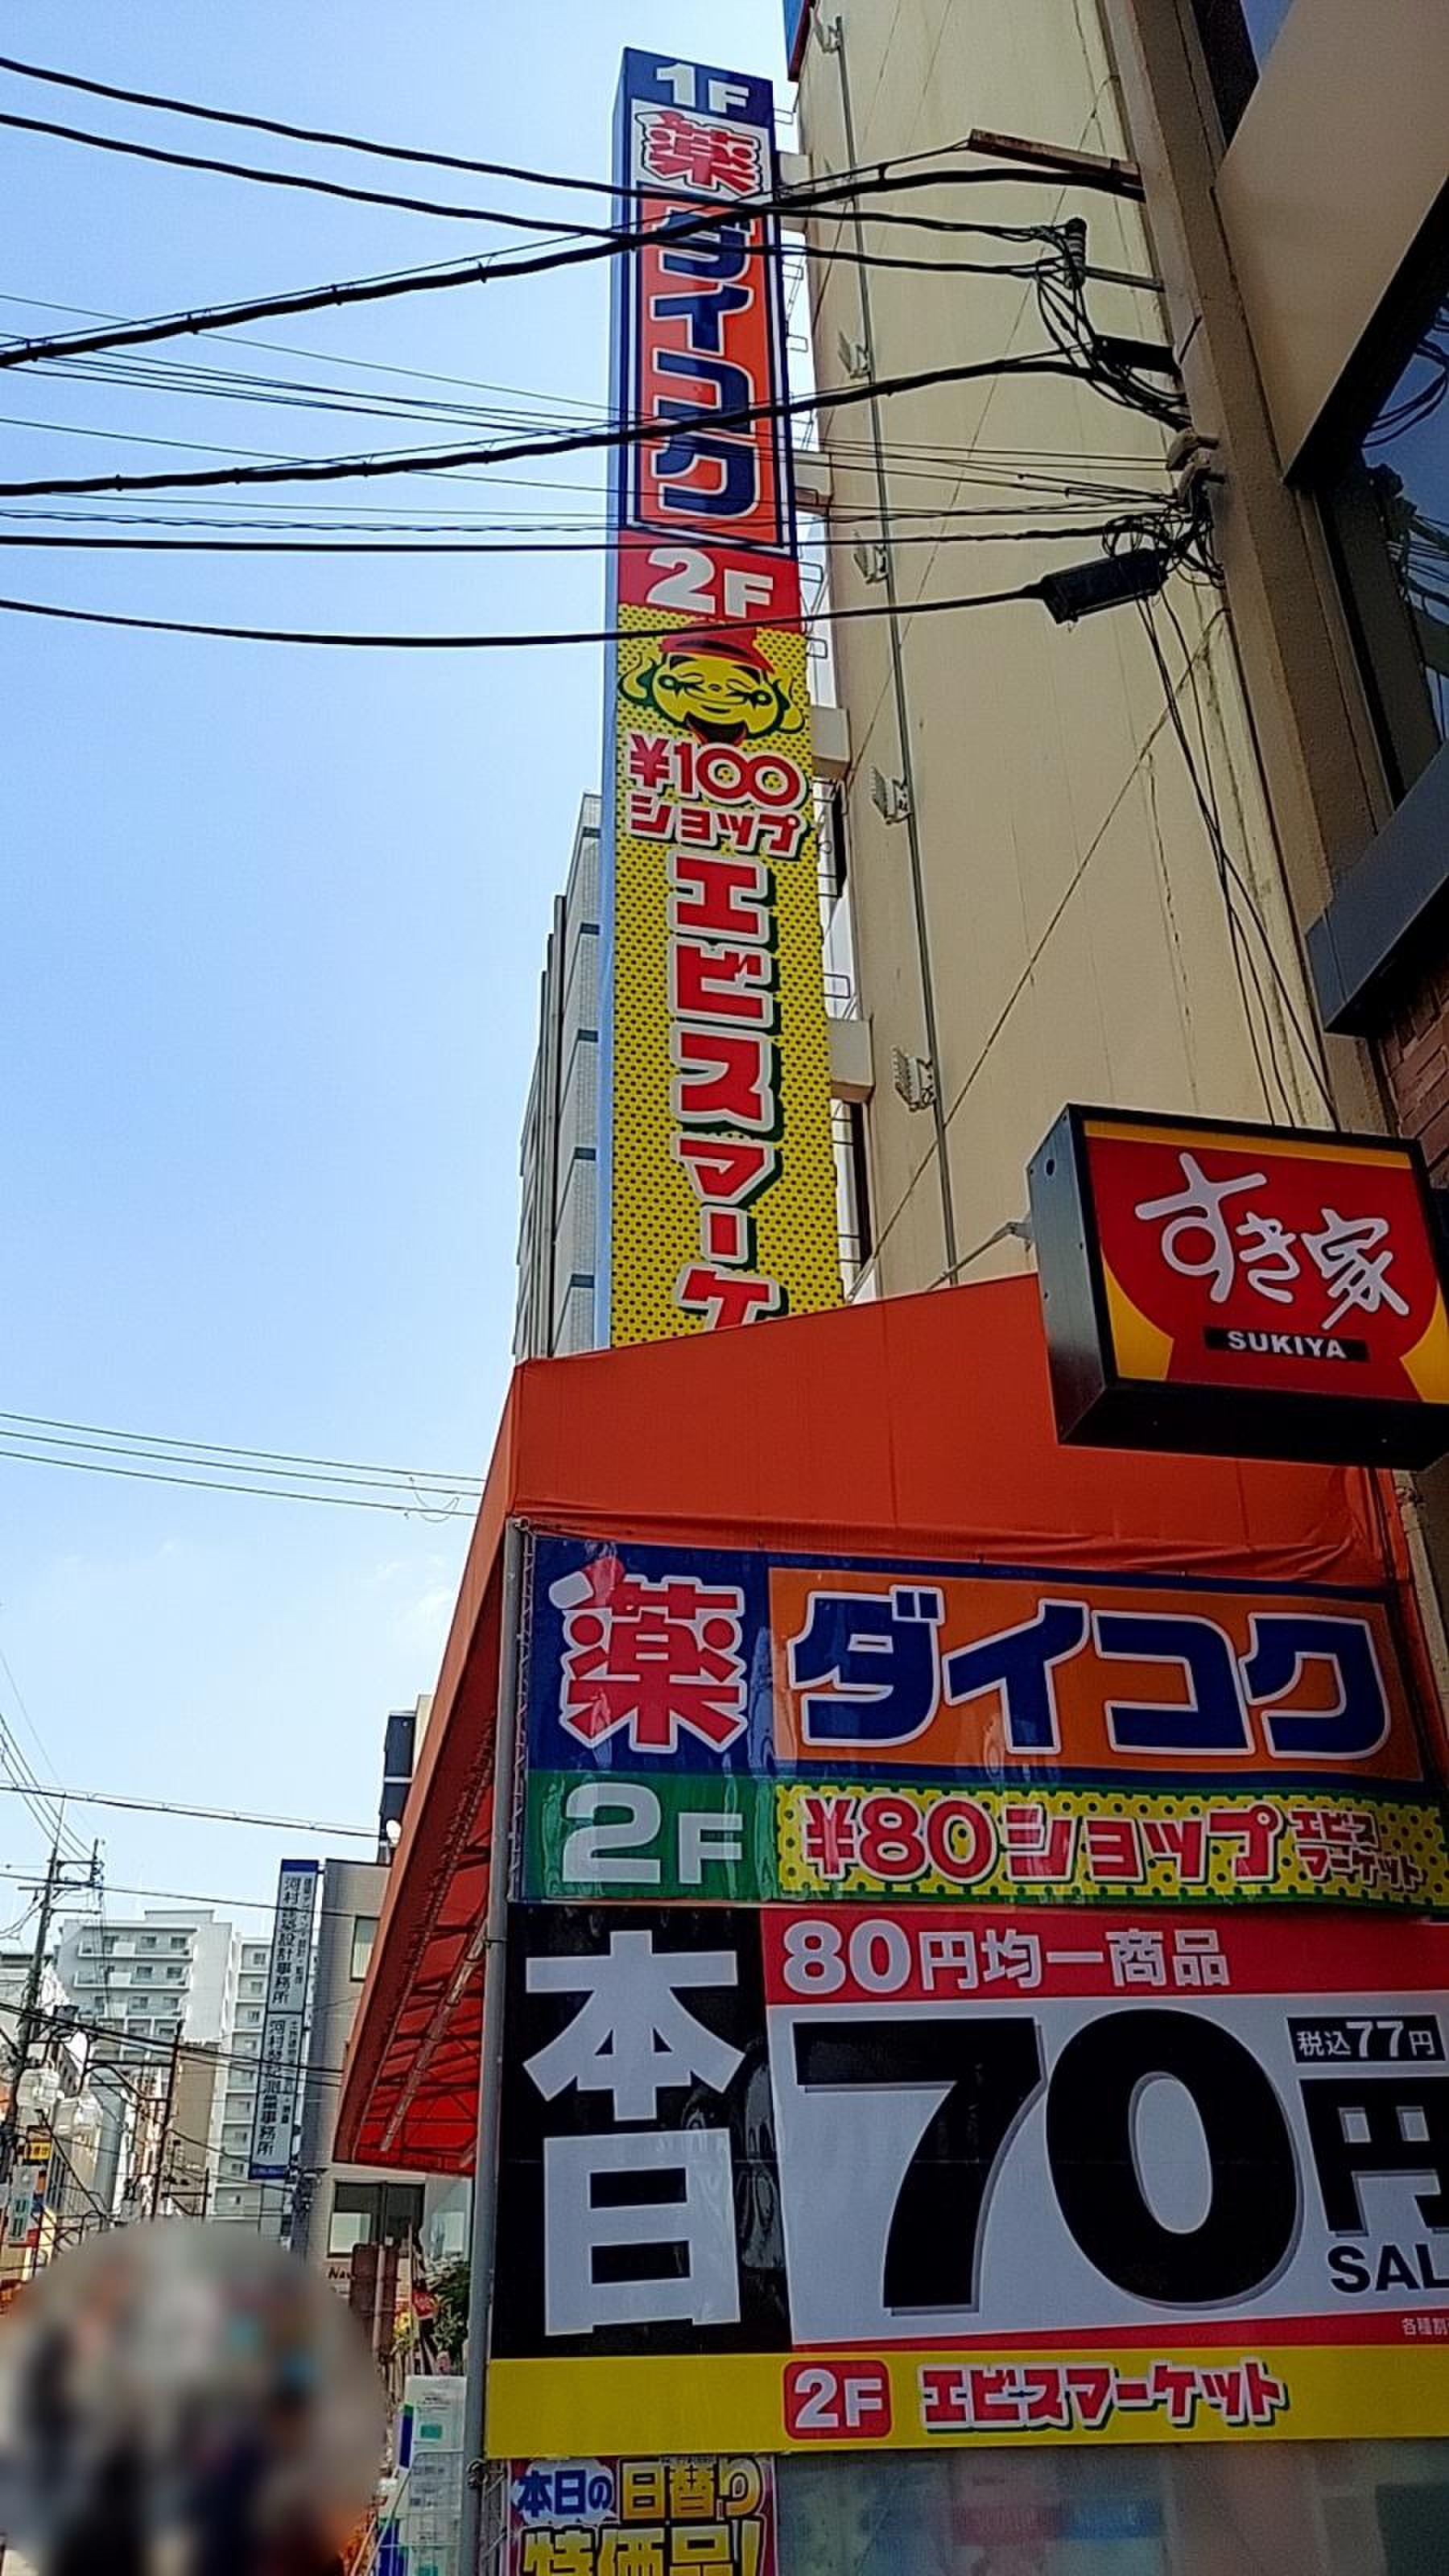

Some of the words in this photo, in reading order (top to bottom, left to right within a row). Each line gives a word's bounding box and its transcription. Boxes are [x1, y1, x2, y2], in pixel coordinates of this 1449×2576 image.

[655, 63, 749, 112] 1F
[636, 109, 762, 198] 薬
[648, 205, 760, 518] ダイコク
[646, 547, 773, 618] 2F
[629, 733, 803, 806] ¥100
[628, 793, 803, 857] ショップ
[1135, 1152, 1410, 1330] すき家
[1227, 1331, 1348, 1359] SUKIYA
[549, 1558, 748, 1754] 薬
[787, 1584, 1390, 1760] ダイコク
[562, 1782, 743, 1885] 2F
[784, 1919, 1230, 1996] 80円均一商品
[1297, 2021, 1436, 2058] 税込77円
[523, 1930, 746, 2335] 本日
[795, 2368, 883, 2428] 2F
[919, 2356, 1288, 2433] エビスマーケット
[516, 2468, 613, 2518] 本日の
